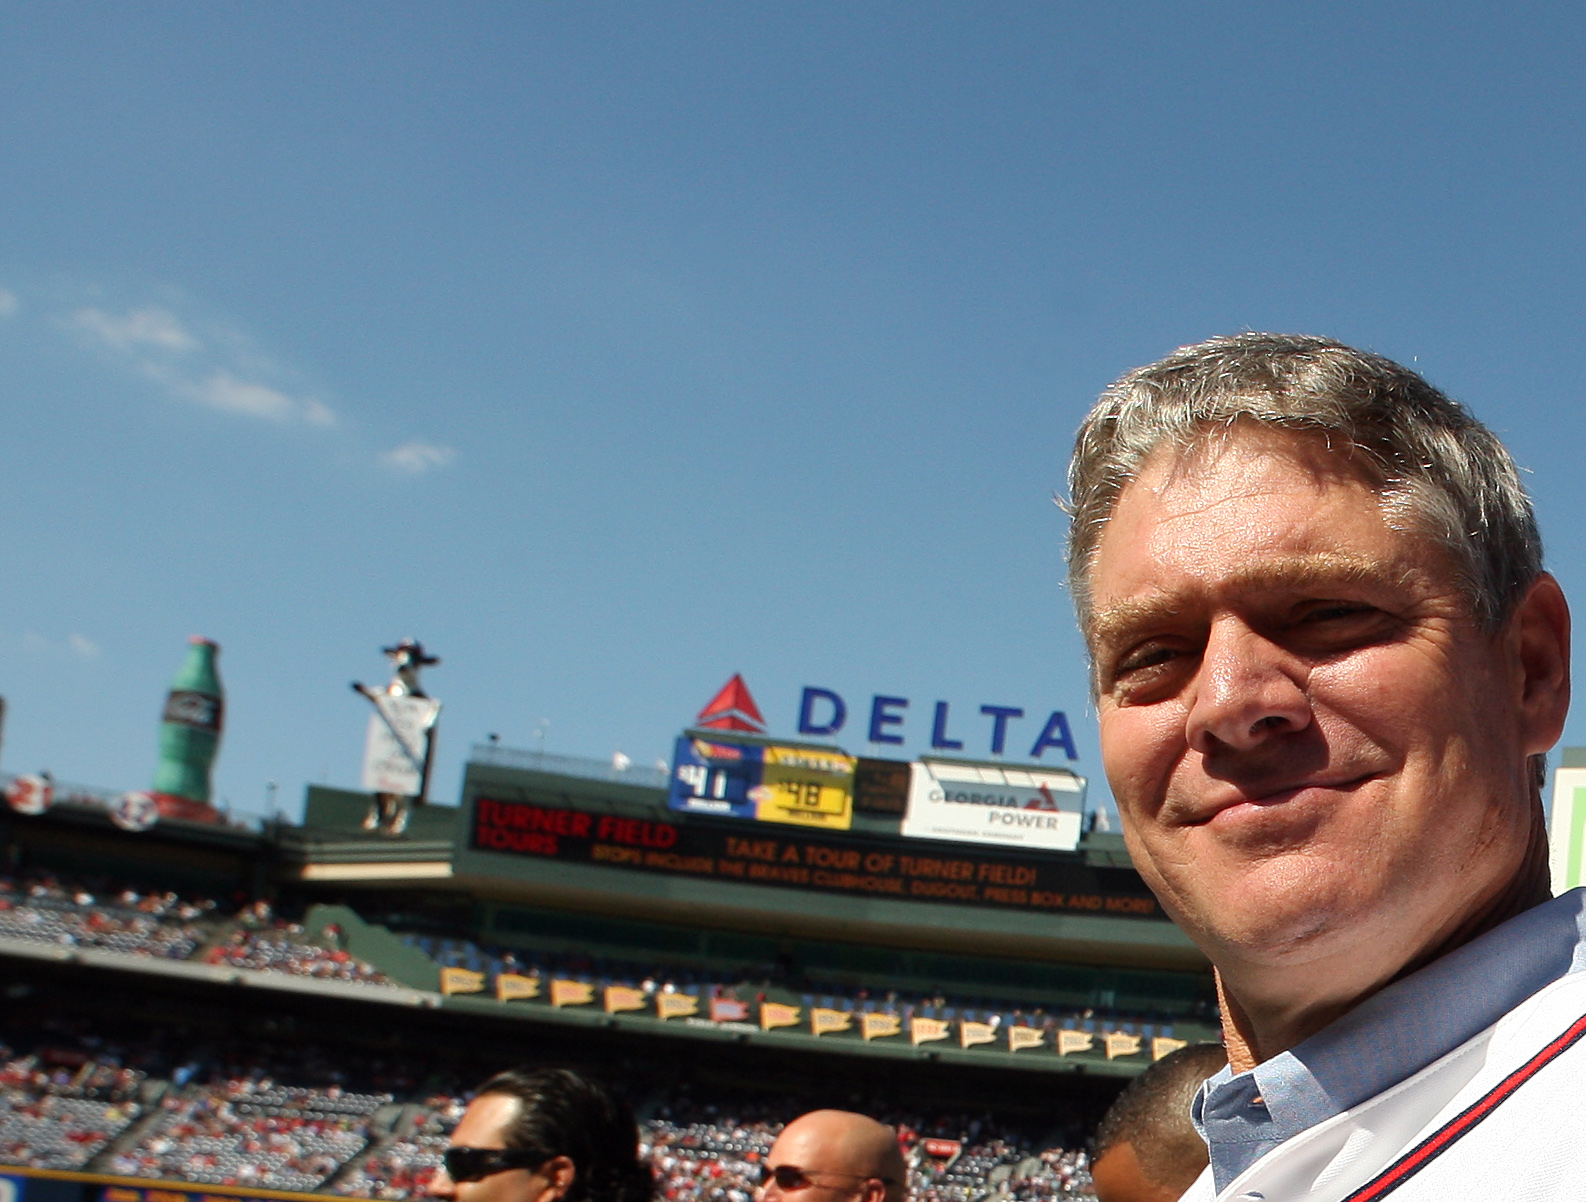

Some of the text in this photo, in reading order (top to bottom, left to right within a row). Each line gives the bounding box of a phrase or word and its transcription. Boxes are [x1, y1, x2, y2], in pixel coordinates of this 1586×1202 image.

[799, 686, 1078, 761] DELTA
[929, 789, 1018, 809] GEORGIA
[989, 811, 1059, 830] POWER
[476, 799, 678, 848] TURNER FIELD
[726, 836, 778, 861] TAKE
[781, 845, 800, 862] A
[804, 845, 860, 870] TOUR
[865, 854, 896, 873] OF
[901, 855, 975, 881] TURNER
